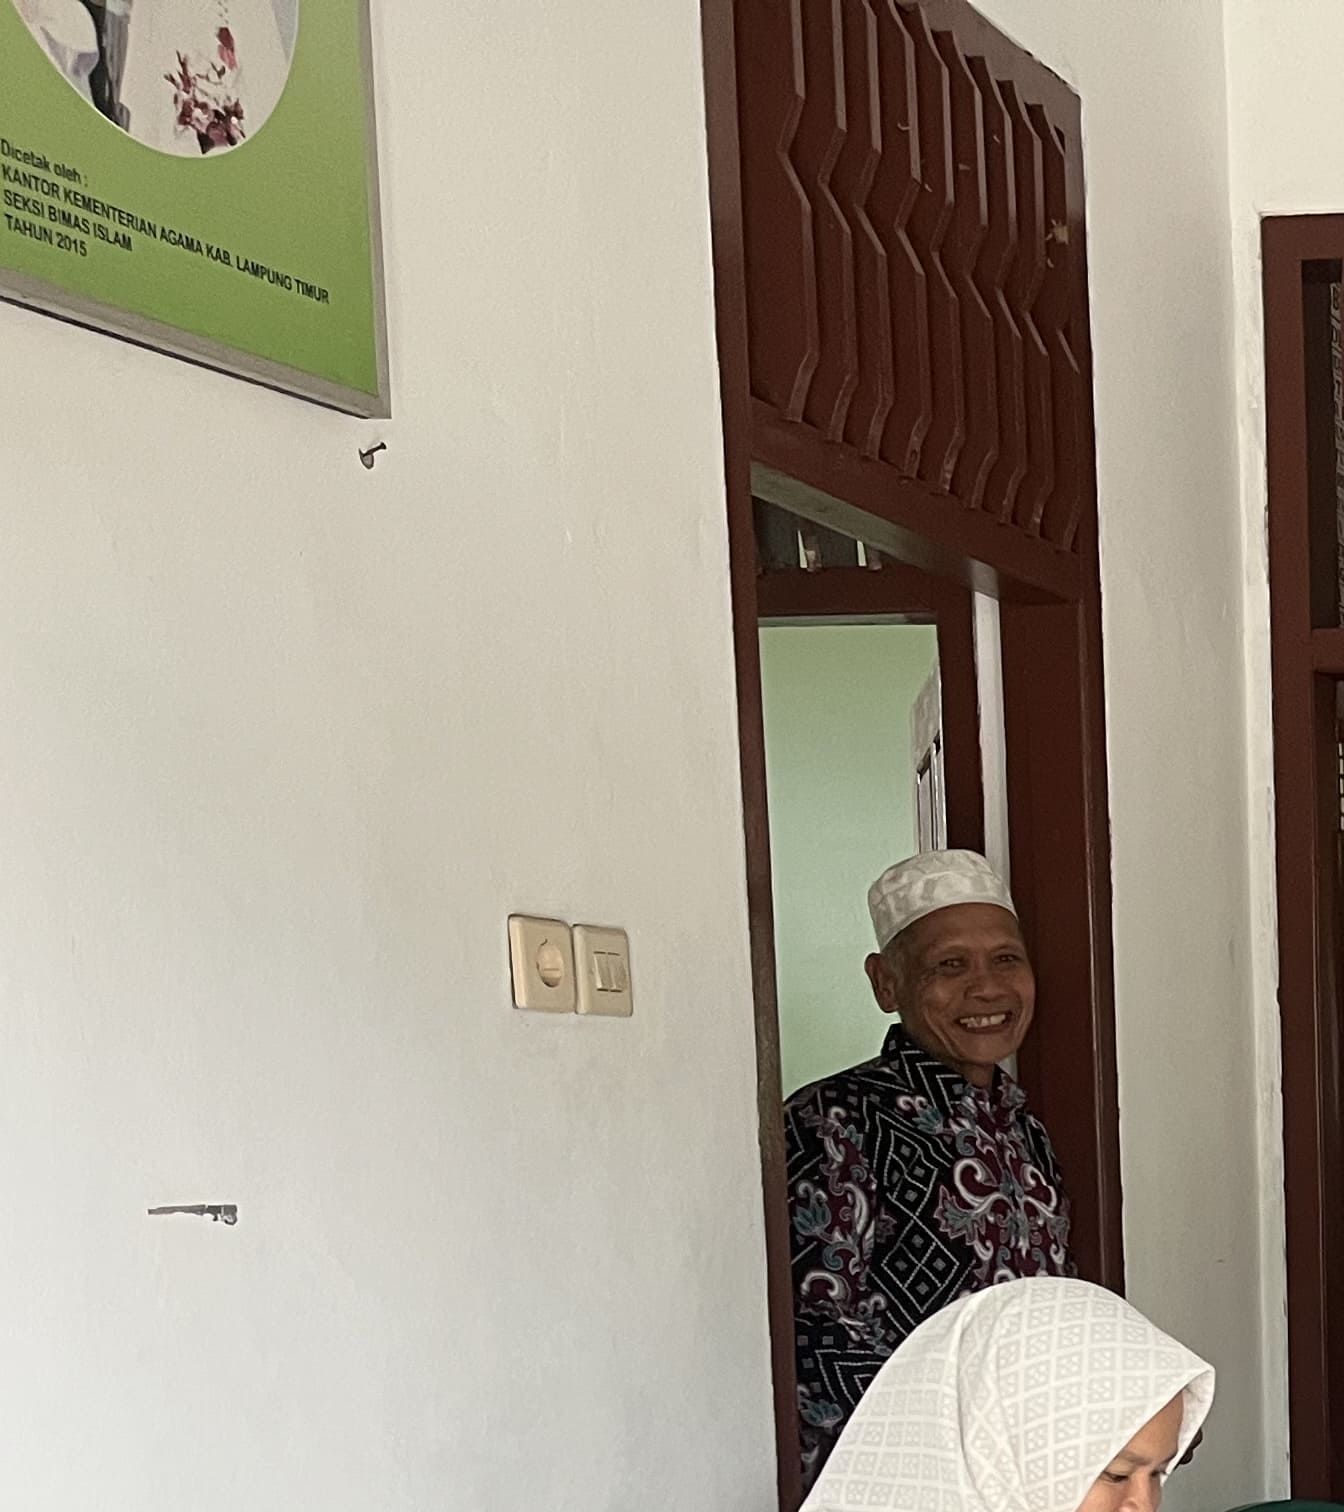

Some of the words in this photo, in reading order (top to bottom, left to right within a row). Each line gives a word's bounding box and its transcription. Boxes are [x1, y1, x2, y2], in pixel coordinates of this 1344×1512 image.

[0, 138, 50, 173] Dicetak
[54, 161, 82, 185] oleh
[1, 163, 60, 200] KANTOR
[63, 187, 157, 239] KEMENTERIAN
[160, 226, 204, 257] AGAMA
[205, 243, 233, 268] KAB.
[236, 255, 292, 291] LAMPUNG
[294, 278, 330, 304] TIMUR
[4, 189, 45, 218] SEKSI
[47, 205, 90, 235] BIMAS
[93, 223, 133, 251] ISLAM
[5, 213, 53, 246] TAHUN
[56, 232, 88, 257] 2015
